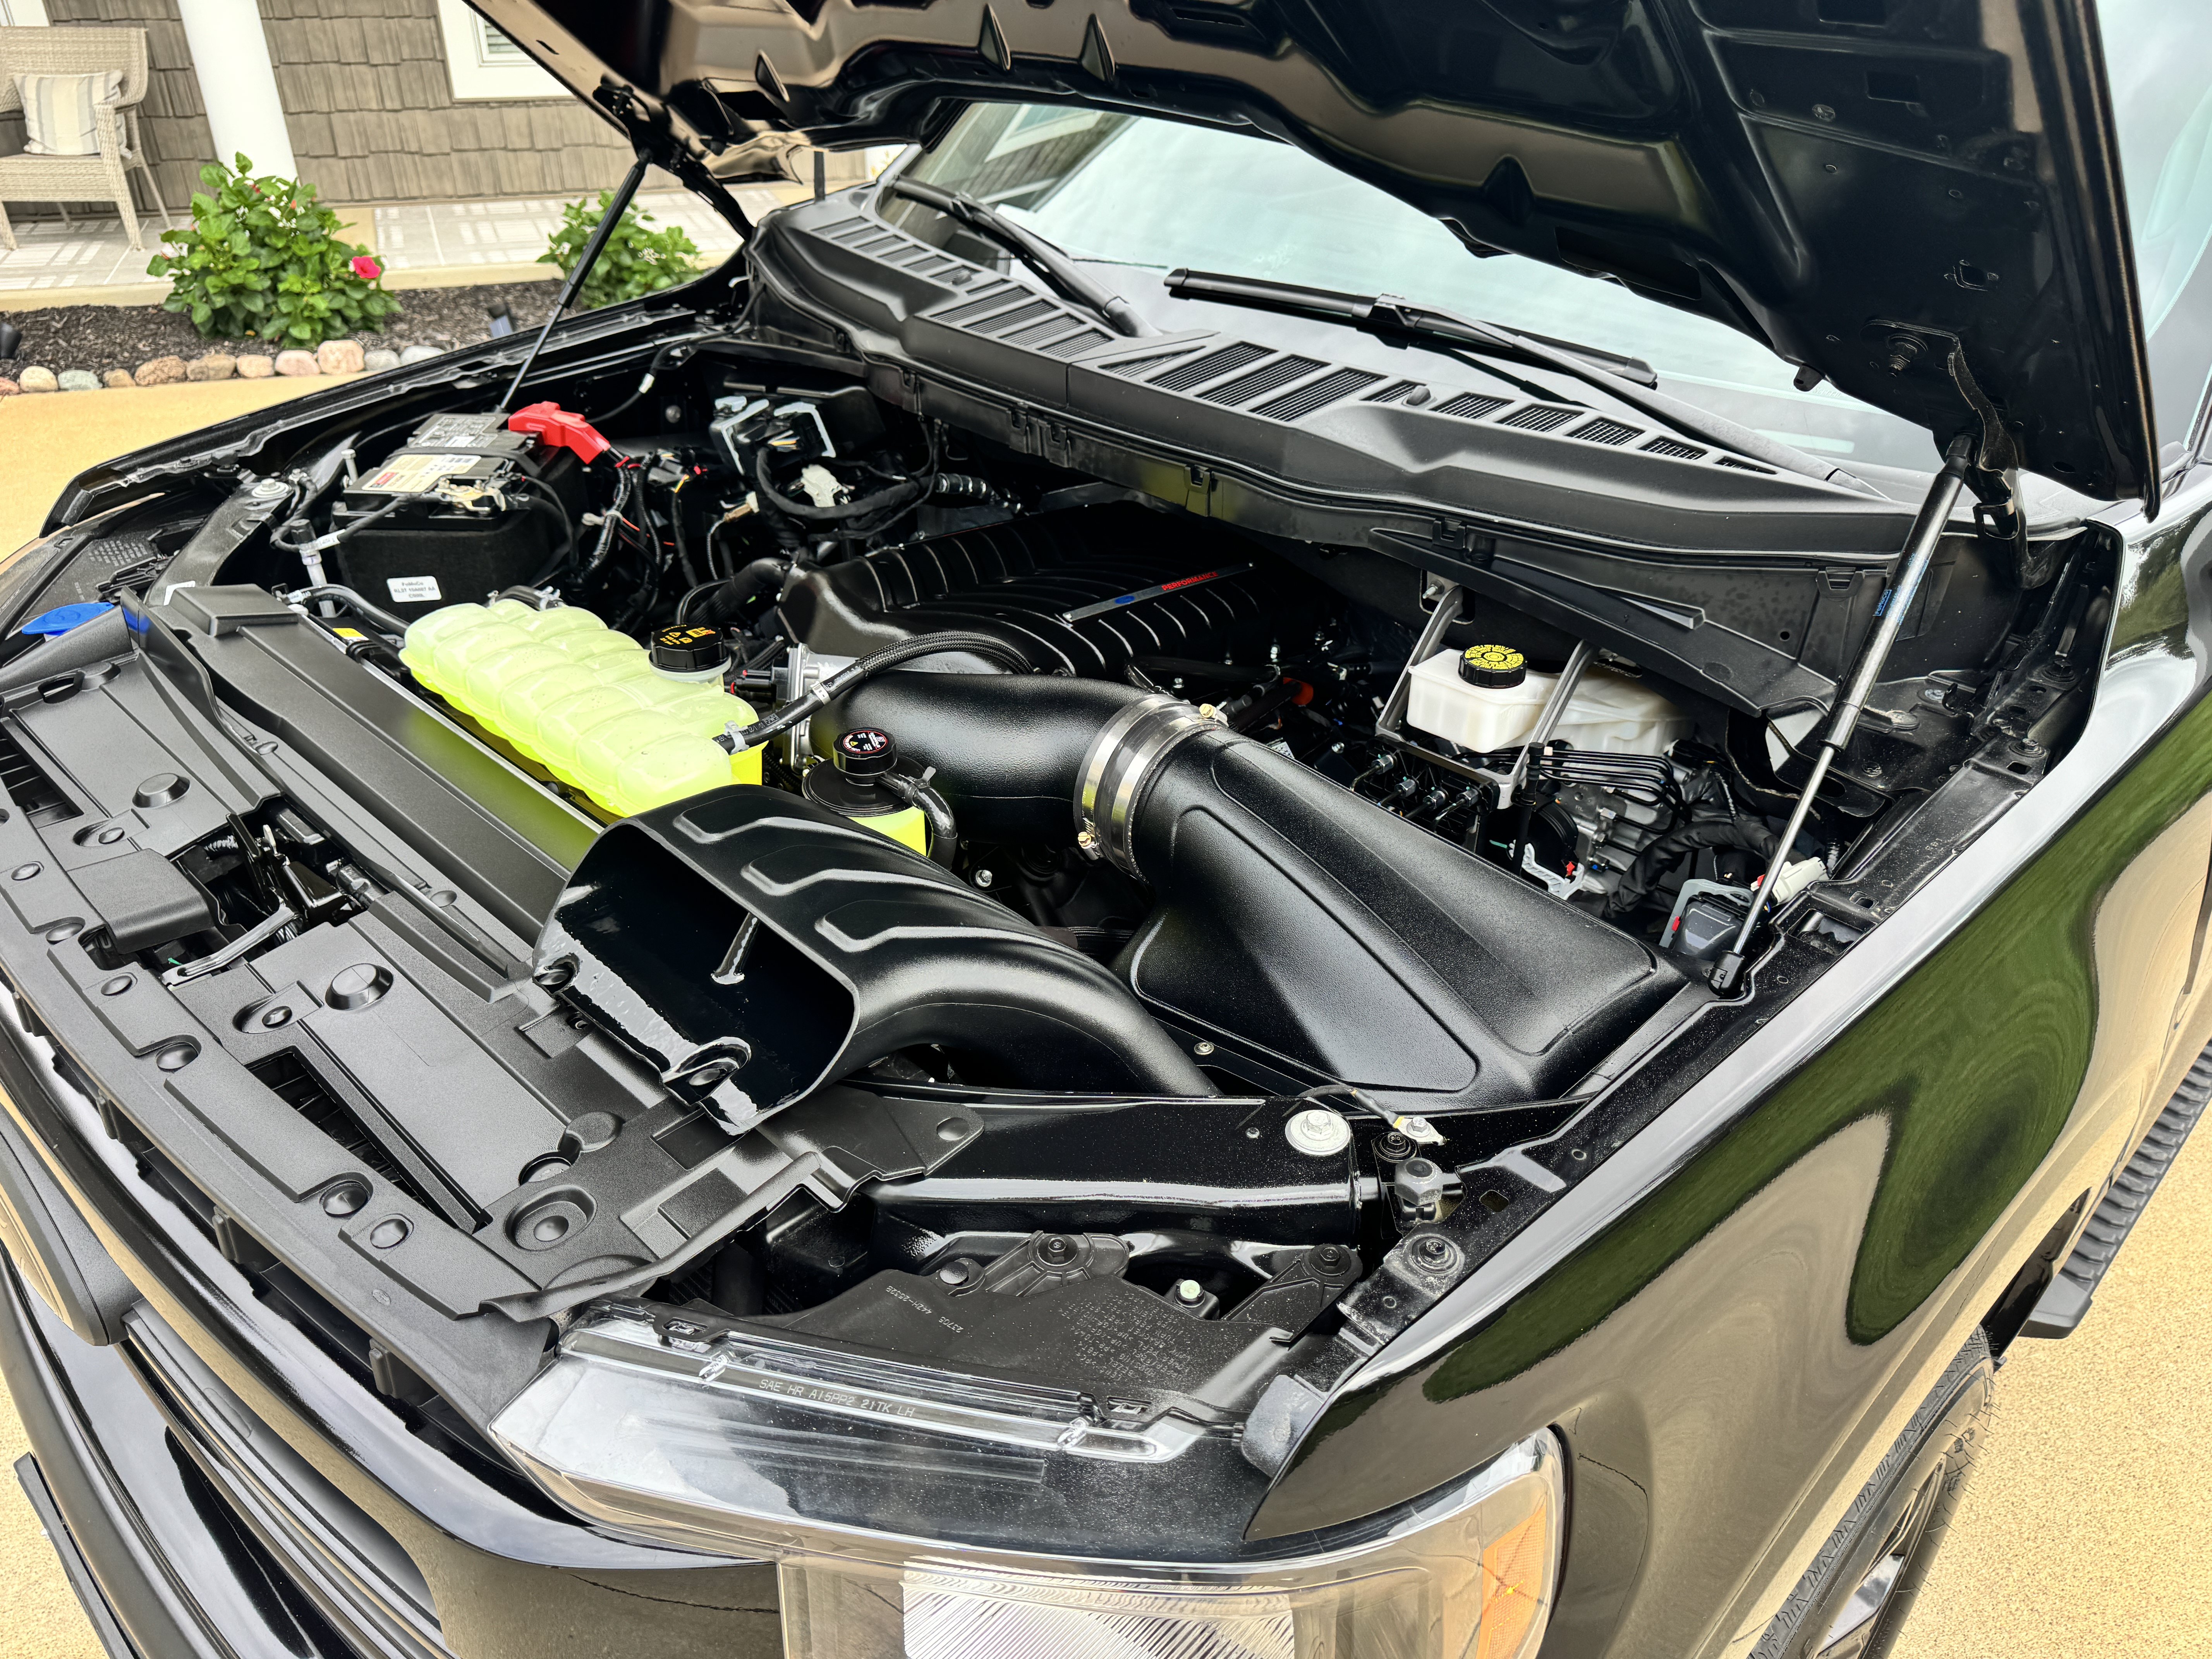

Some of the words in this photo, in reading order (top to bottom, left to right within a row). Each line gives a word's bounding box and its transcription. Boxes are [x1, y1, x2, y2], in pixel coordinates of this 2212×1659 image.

[1161, 571, 1219, 591] PERFORMANCE
[1875, 591, 1889, 615] FoMoCo
[759, 1379, 783, 1392] SAE
[787, 1385, 804, 1396] HR
[860, 1399, 893, 1413] 21TK
[897, 1405, 915, 1417] LH
